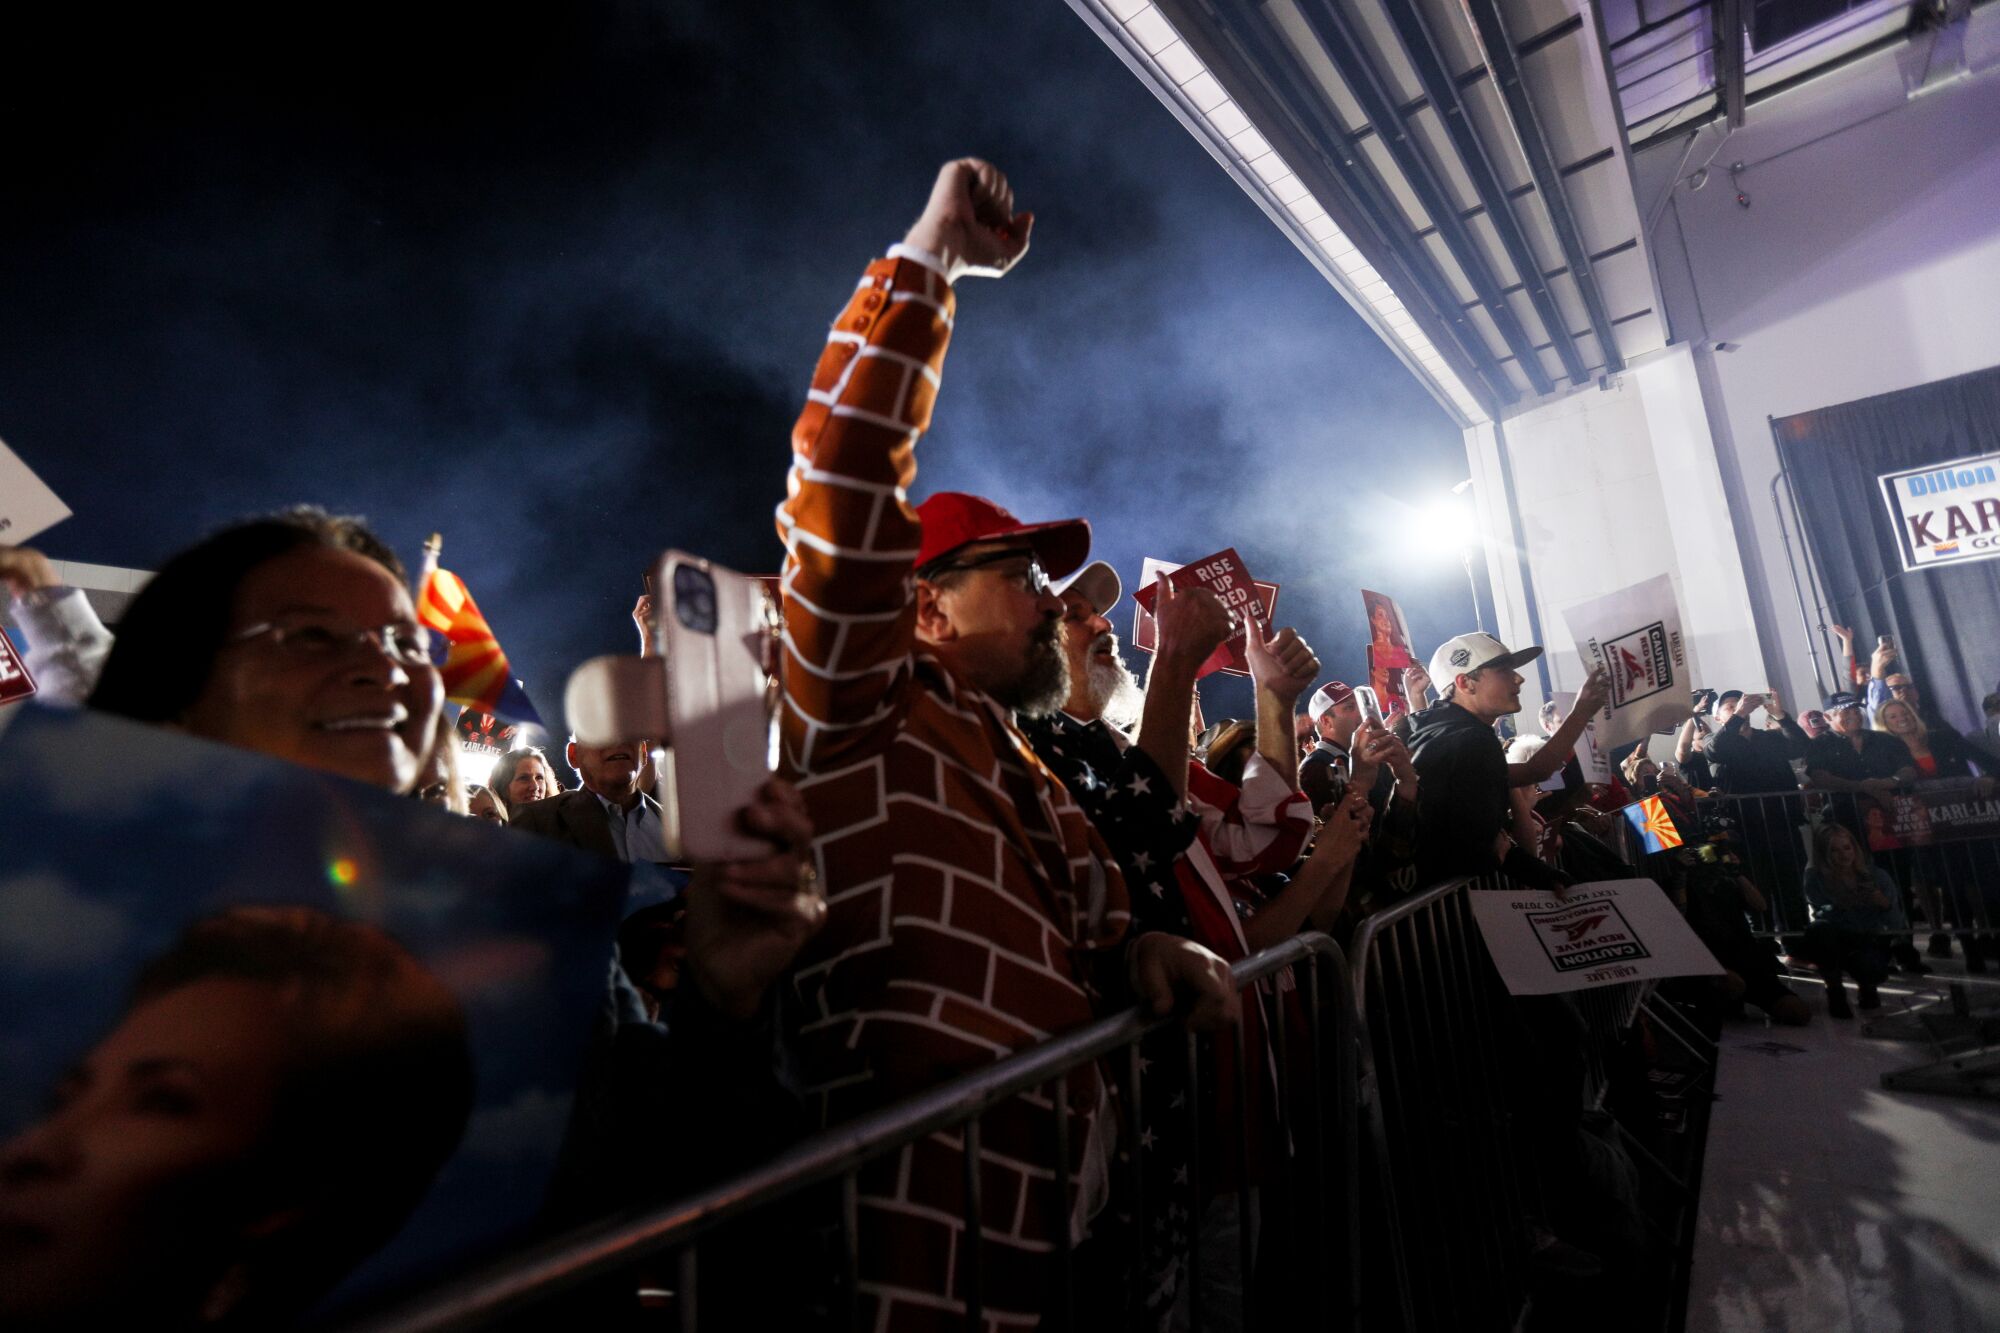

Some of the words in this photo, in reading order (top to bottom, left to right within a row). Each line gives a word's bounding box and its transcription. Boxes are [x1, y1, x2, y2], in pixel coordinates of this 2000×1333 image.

[1906, 465, 1996, 497] Dillon
[1195, 557, 1235, 582] RISE
[1212, 574, 1234, 593] UP
[1231, 598, 1264, 625] AVE!
[1588, 636, 1602, 659] TEXT
[1640, 636, 1651, 657] RED
[1651, 630, 1669, 684] CAUTION
[1609, 645, 1625, 703] APPROACHING
[1645, 657, 1655, 688] WAVE
[1928, 802, 1970, 824] KARI
[1591, 889, 1620, 899] TEXT
[1511, 902, 1544, 911] 70789
[1533, 904, 1611, 925] APPROACHING
[1545, 901, 1561, 909] TO
[1555, 938, 1597, 953] WAVE
[1599, 932, 1627, 945] RED
[1562, 945, 1637, 966] CAUTION
